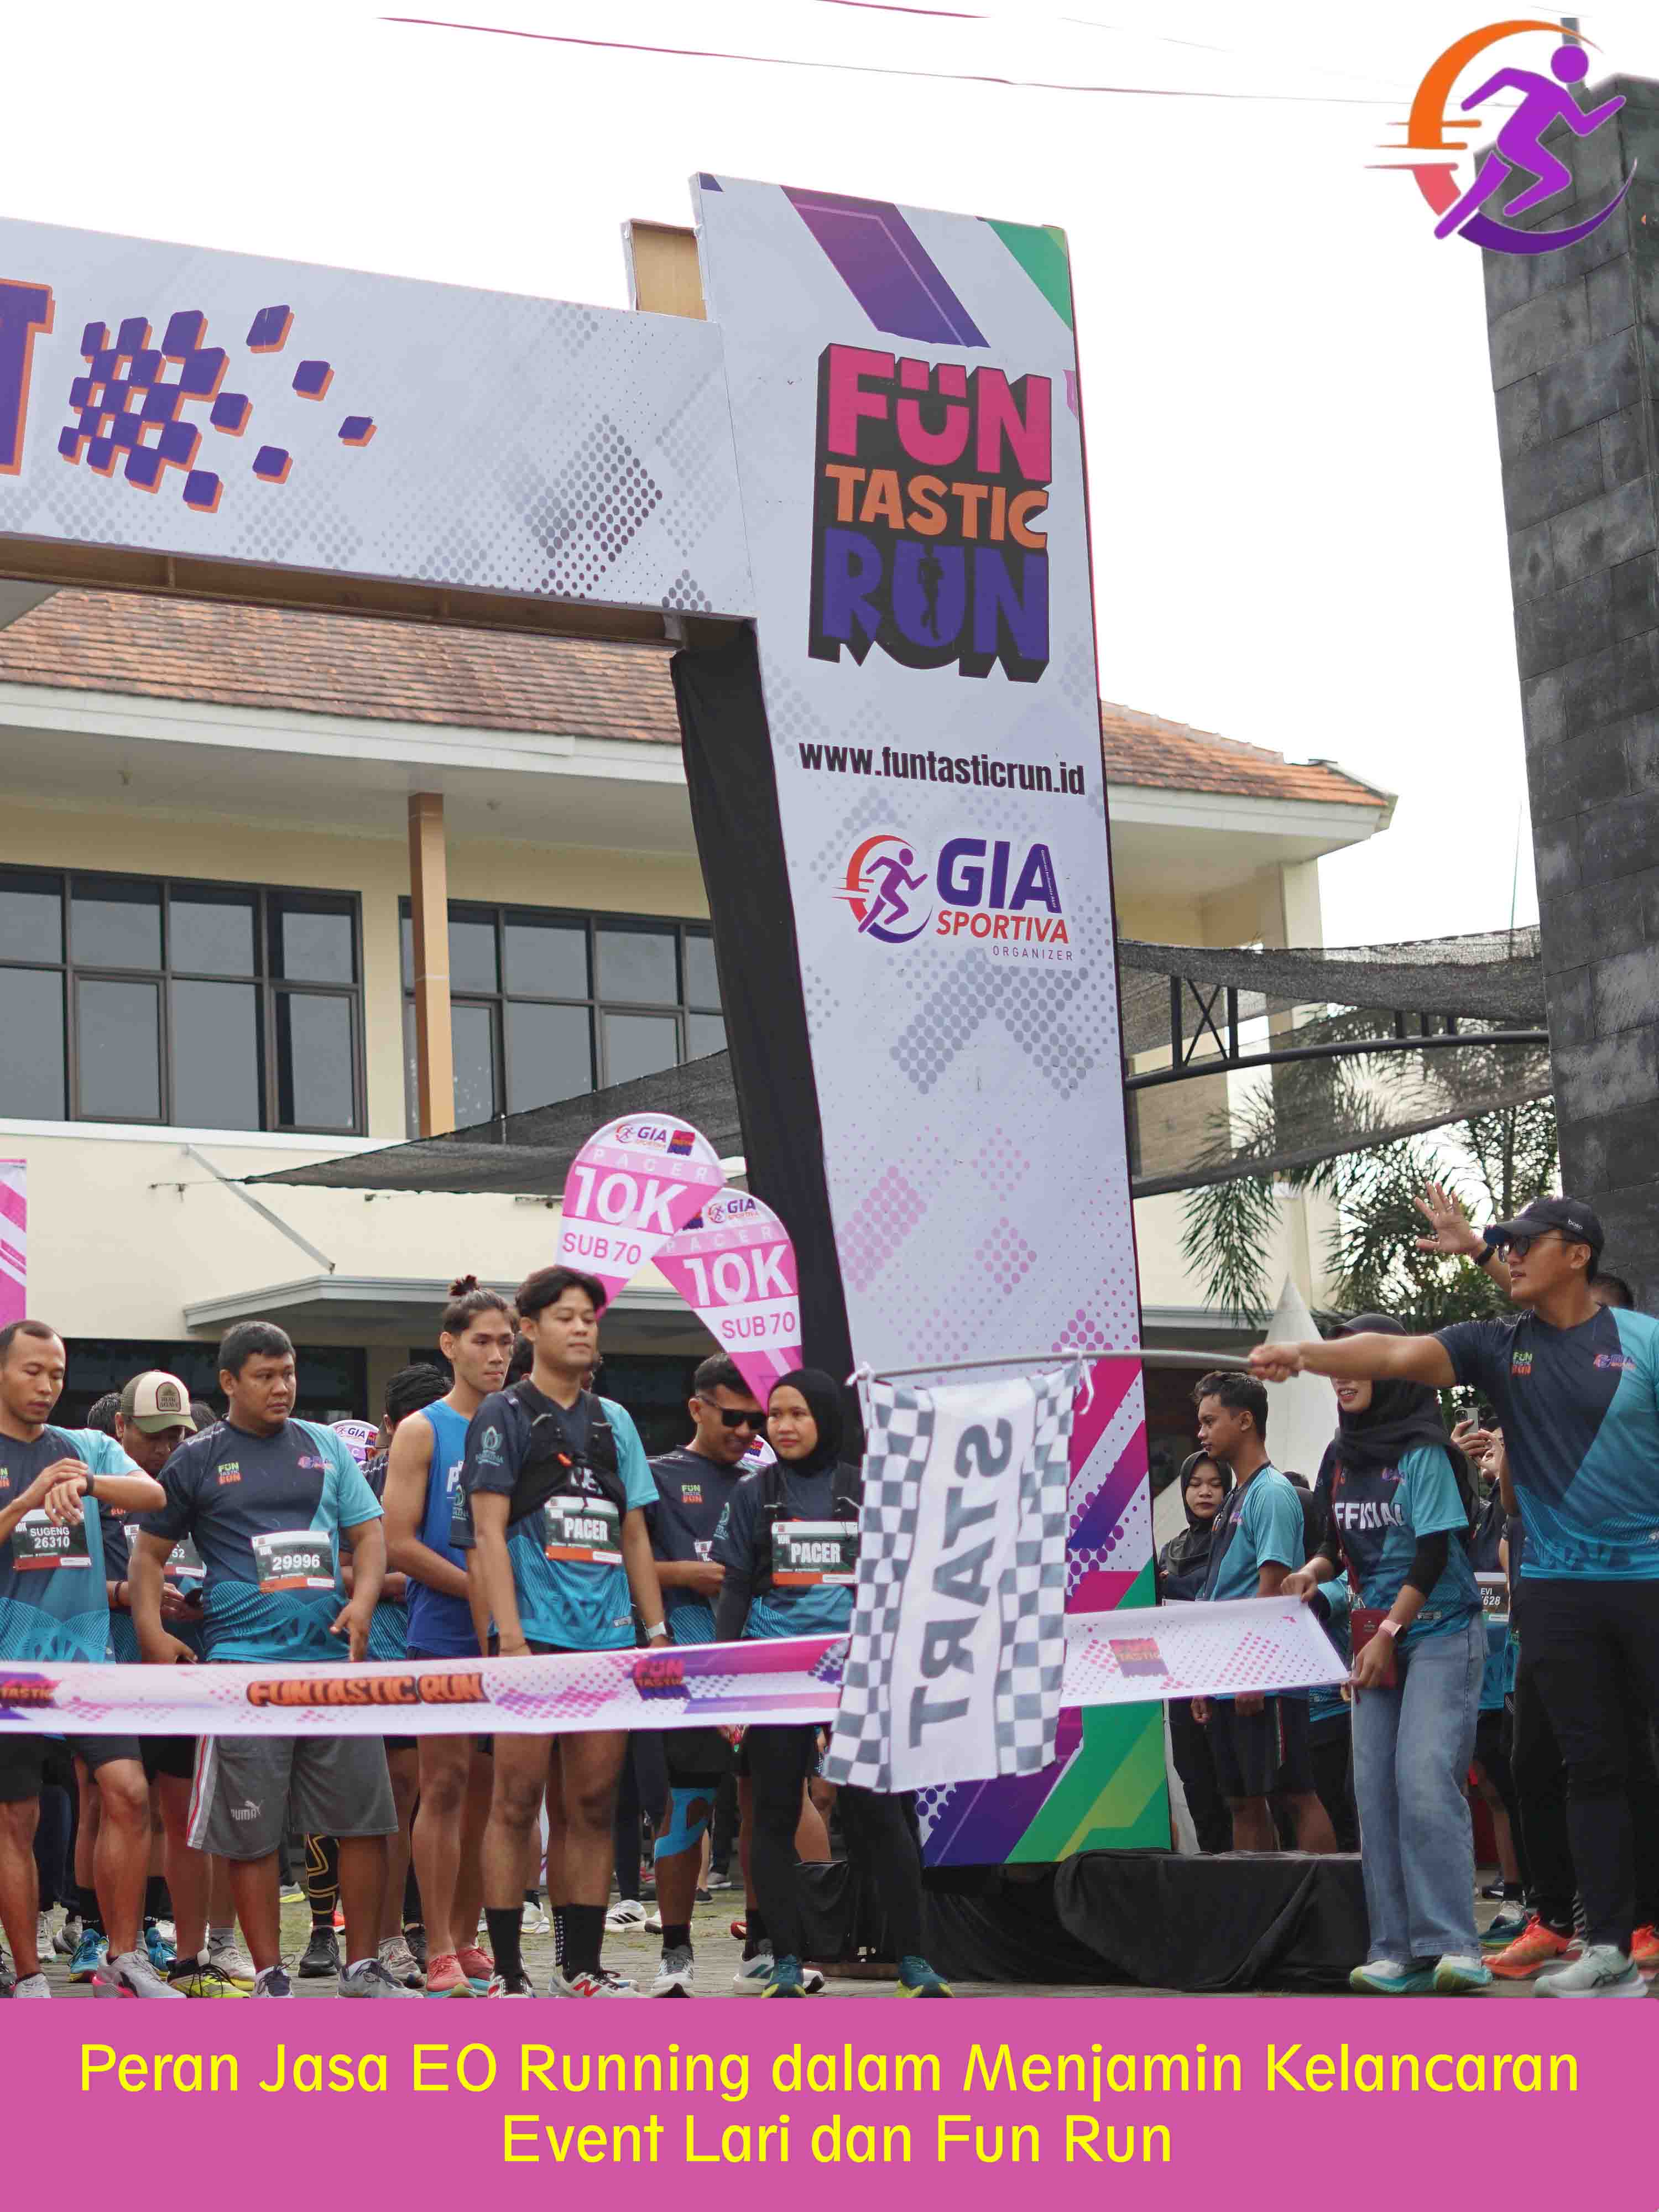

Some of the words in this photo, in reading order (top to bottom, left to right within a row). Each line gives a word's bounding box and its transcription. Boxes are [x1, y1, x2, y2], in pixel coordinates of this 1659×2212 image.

[825, 463, 1049, 549] TASTIC
[822, 526, 1050, 661] RUN
[799, 743, 1086, 795] www.funtasticrun.id
[936, 838, 1062, 914] GIA
[936, 910, 1070, 944] SPORTIVA
[993, 945, 1073, 961] ORGANIZER
[638, 1126, 667, 1143] GIA
[575, 1166, 688, 1234] 10K
[727, 1198, 757, 1213] GIA
[562, 1232, 609, 1259] SUB
[612, 1241, 642, 1265] 70
[682, 1244, 794, 1307] 10K
[721, 1316, 766, 1339] SUB
[769, 1311, 796, 1334] 70
[348, 1427, 366, 1439] GIA
[218, 1462, 239, 1473] FUN
[30, 1526, 70, 1537] SUGENG
[564, 1517, 608, 1542] PACER
[34, 1536, 70, 1549] 26310
[791, 1542, 841, 1563] PACER
[272, 1554, 321, 1572] 29996
[1482, 1596, 1501, 1606] 628
[247, 1676, 418, 1707] FUNTASTIC
[418, 1673, 491, 1704] RUN
